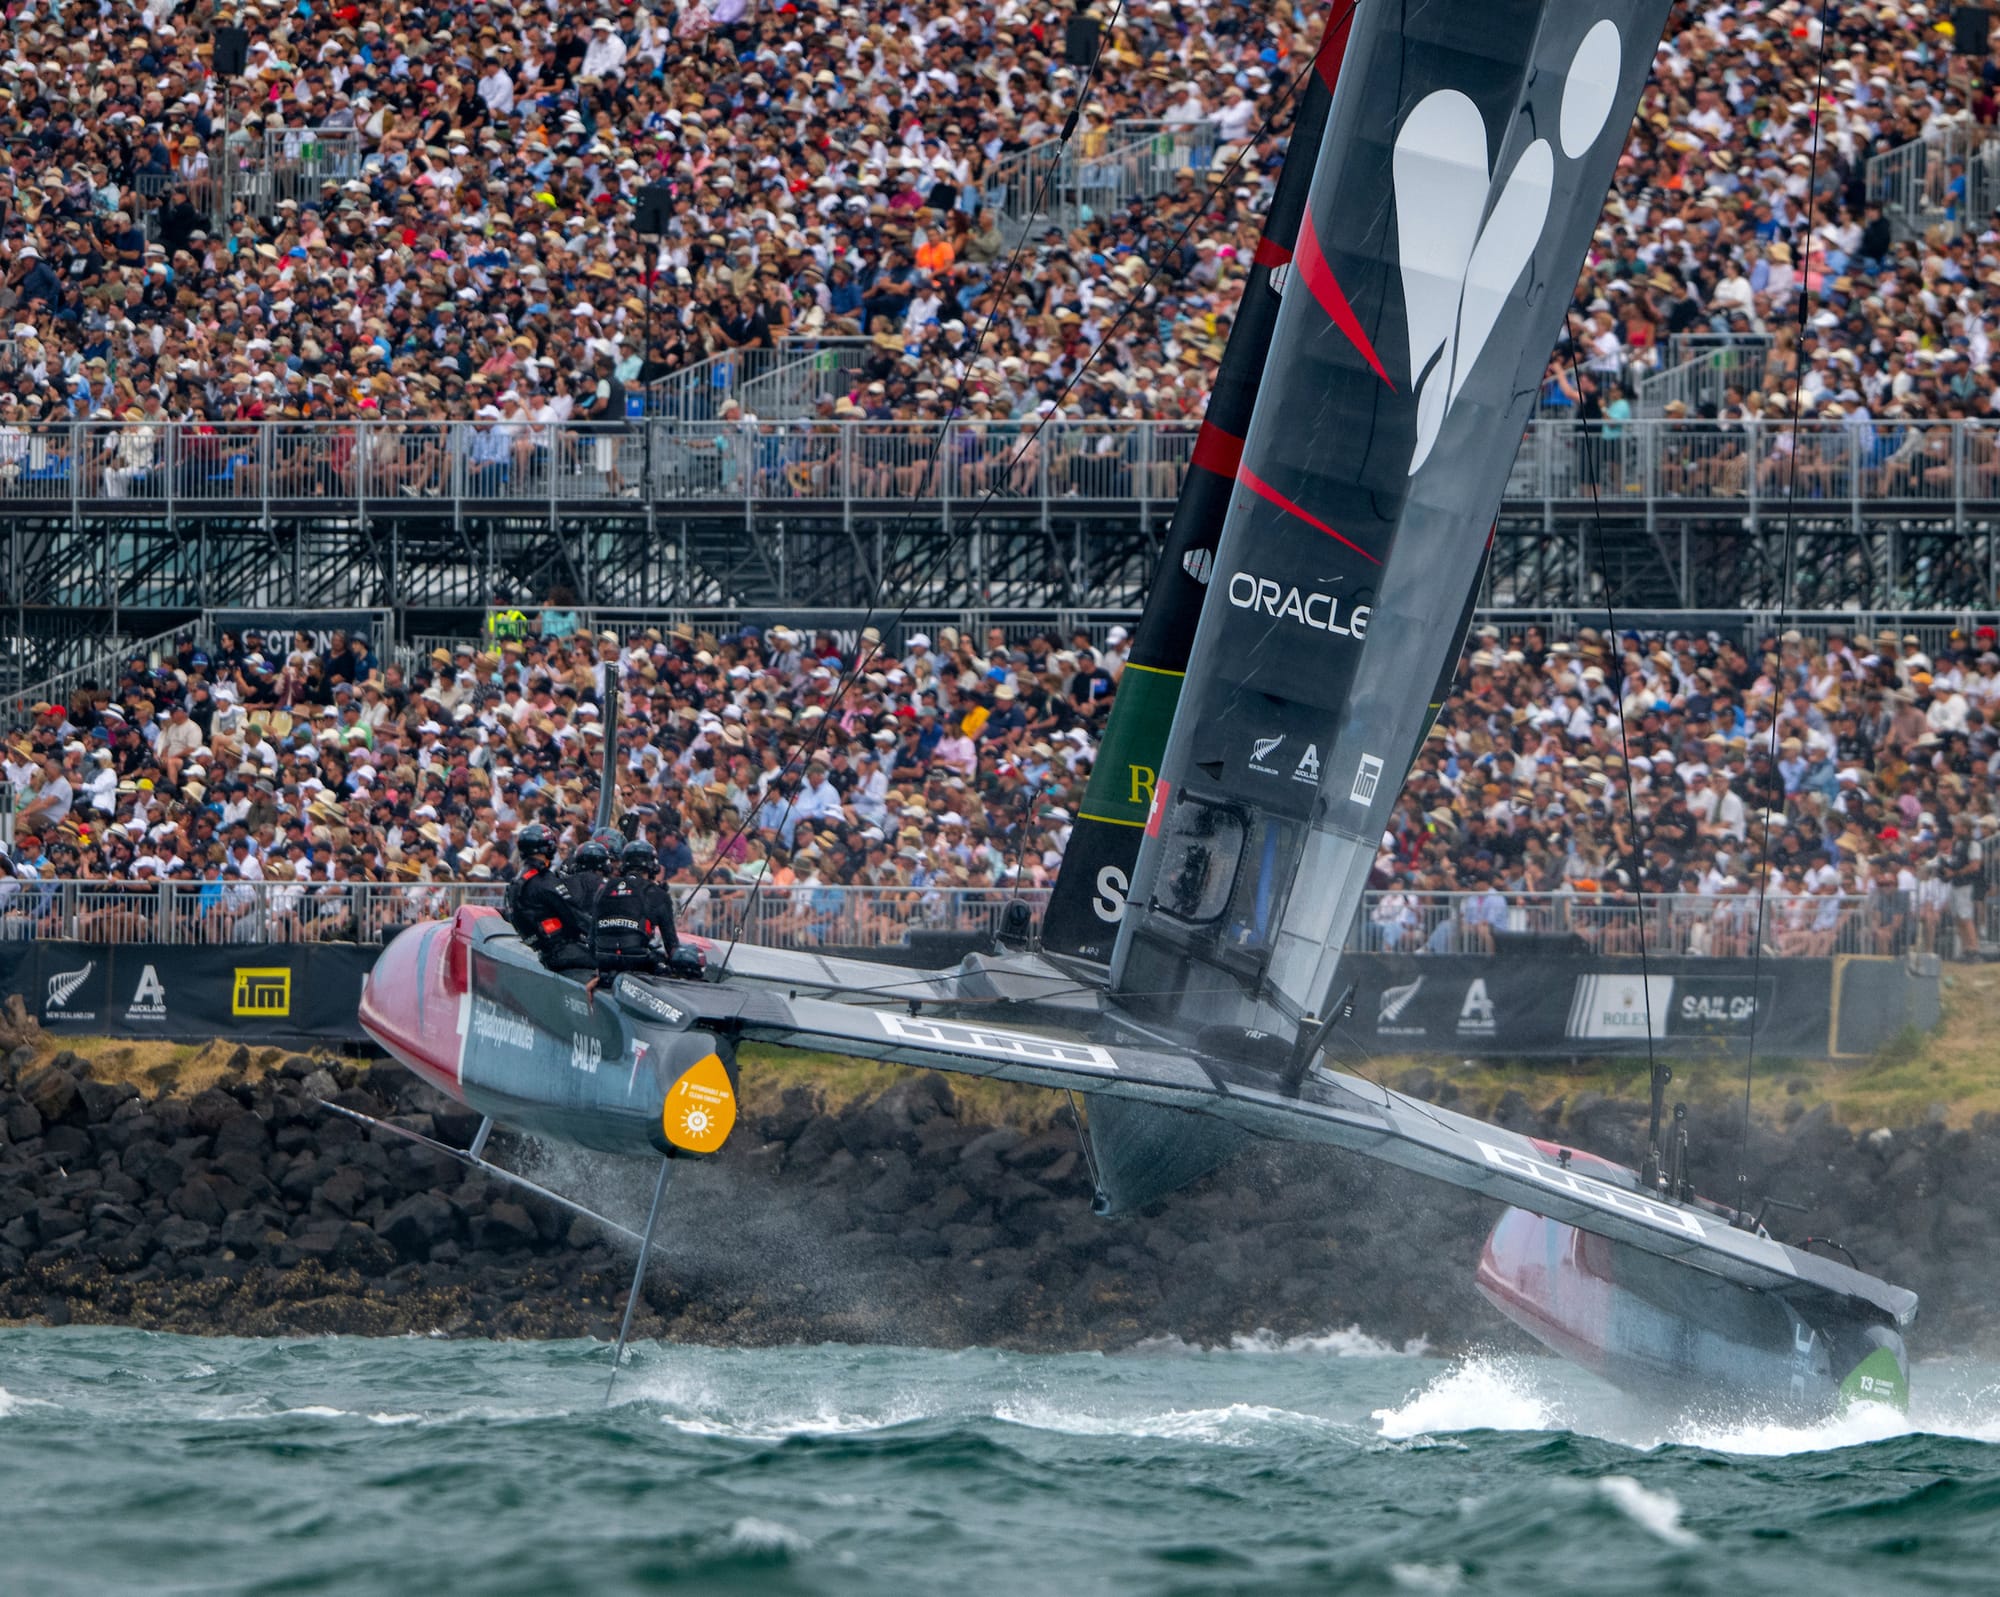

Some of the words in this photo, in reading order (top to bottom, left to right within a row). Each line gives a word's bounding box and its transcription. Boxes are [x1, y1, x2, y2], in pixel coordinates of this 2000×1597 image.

[1229, 571, 1373, 641] ORACLE
[1092, 865, 1129, 923] S
[598, 918, 640, 930] SCHNEITER
[129, 1004, 167, 1013] AUCKLAND
[1602, 1011, 1651, 1026] ROLEX
[679, 1080, 689, 1097] 7
[1860, 1375, 1874, 1392] 13
